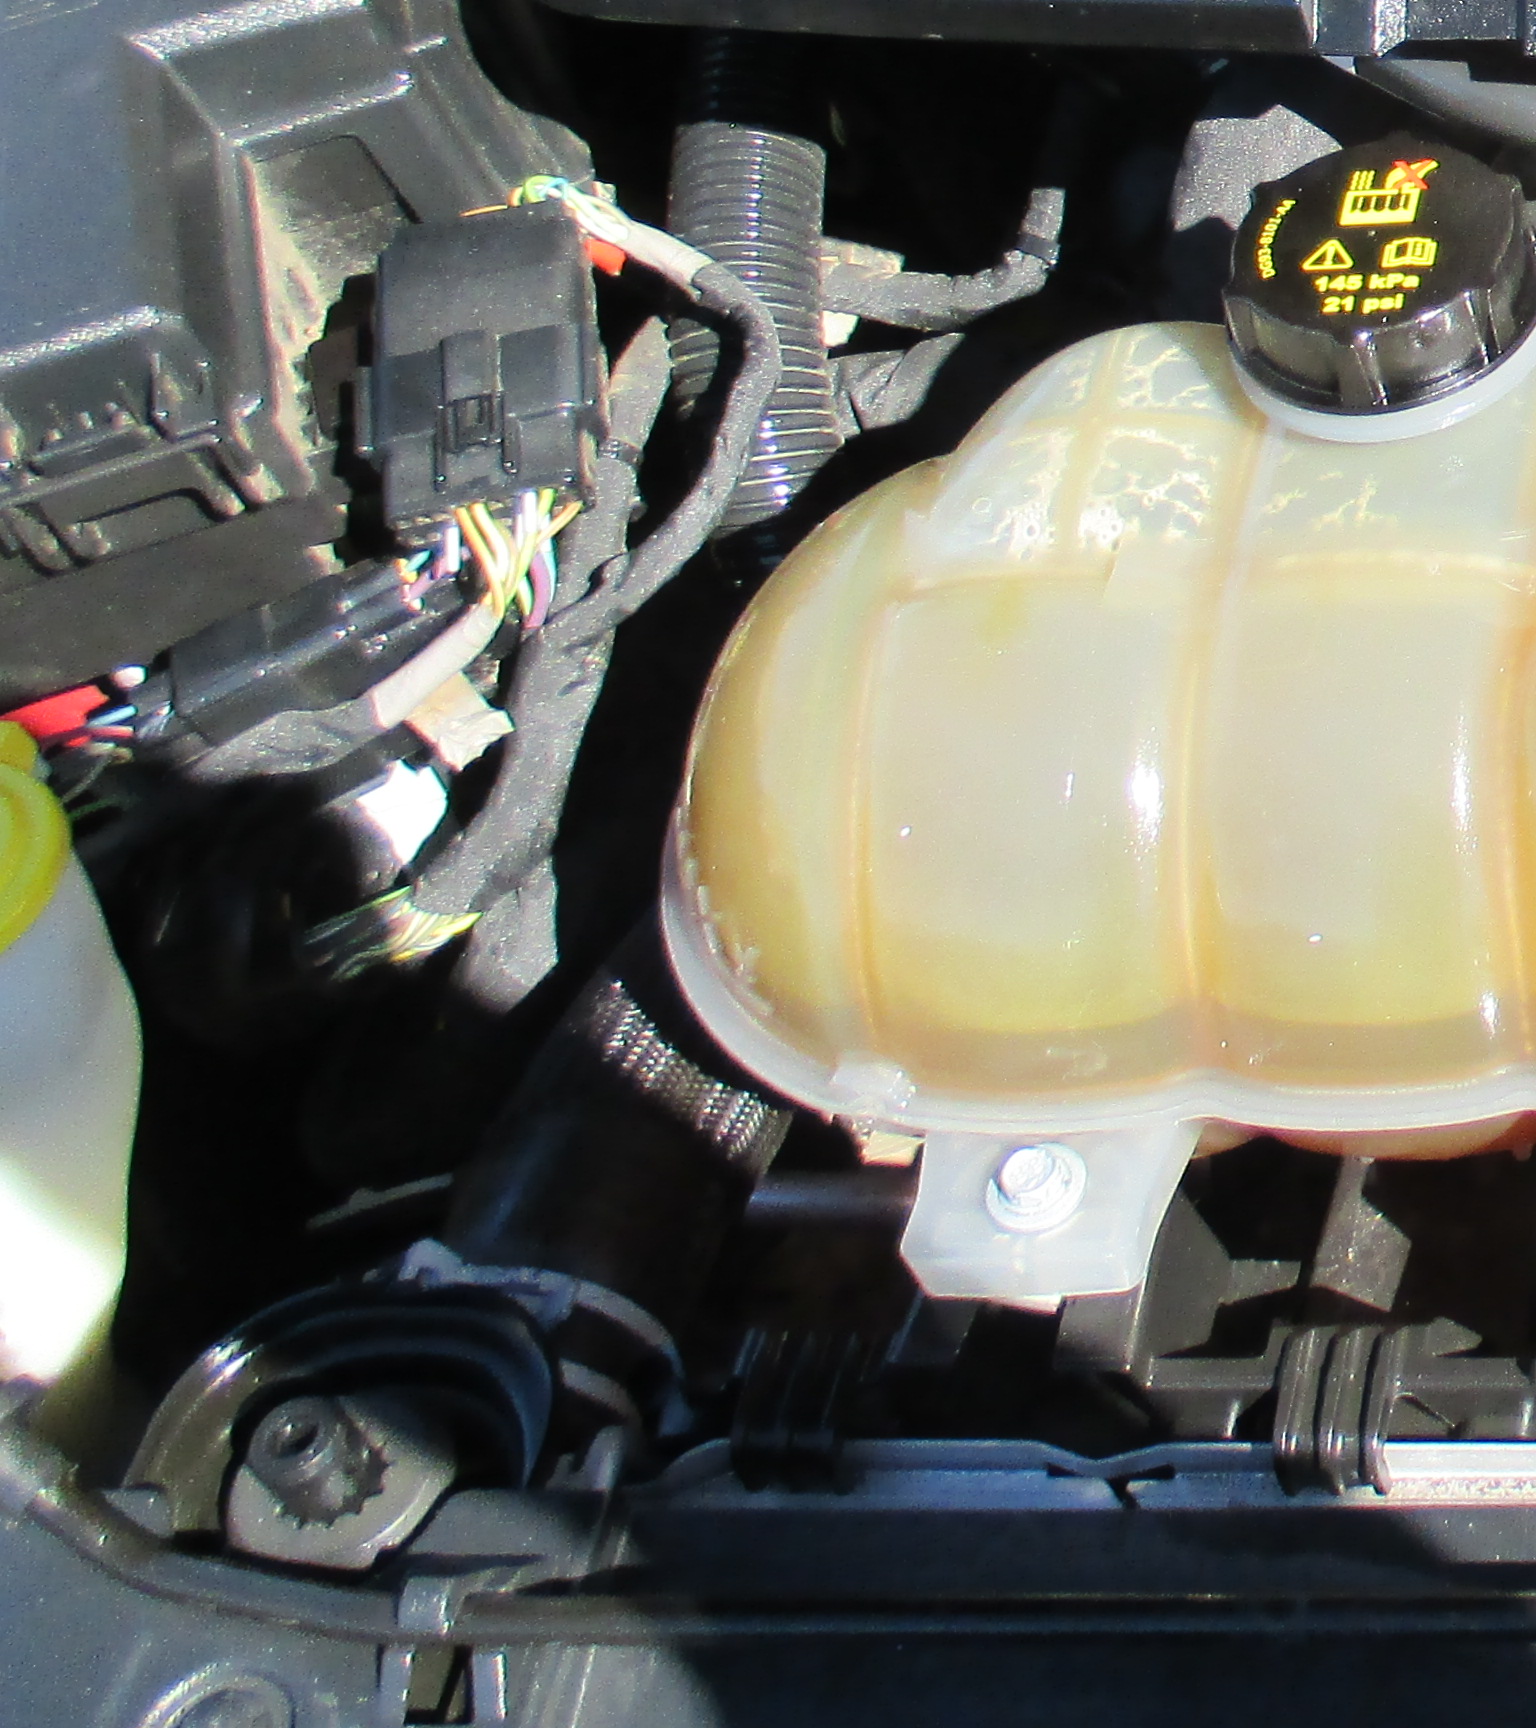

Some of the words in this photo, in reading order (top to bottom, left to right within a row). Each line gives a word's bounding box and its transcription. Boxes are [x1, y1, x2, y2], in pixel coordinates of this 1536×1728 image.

[1314, 273, 1364, 292] 145
[1368, 272, 1420, 290] kPa
[1321, 294, 1355, 313] 21
[1361, 292, 1405, 315] psi
